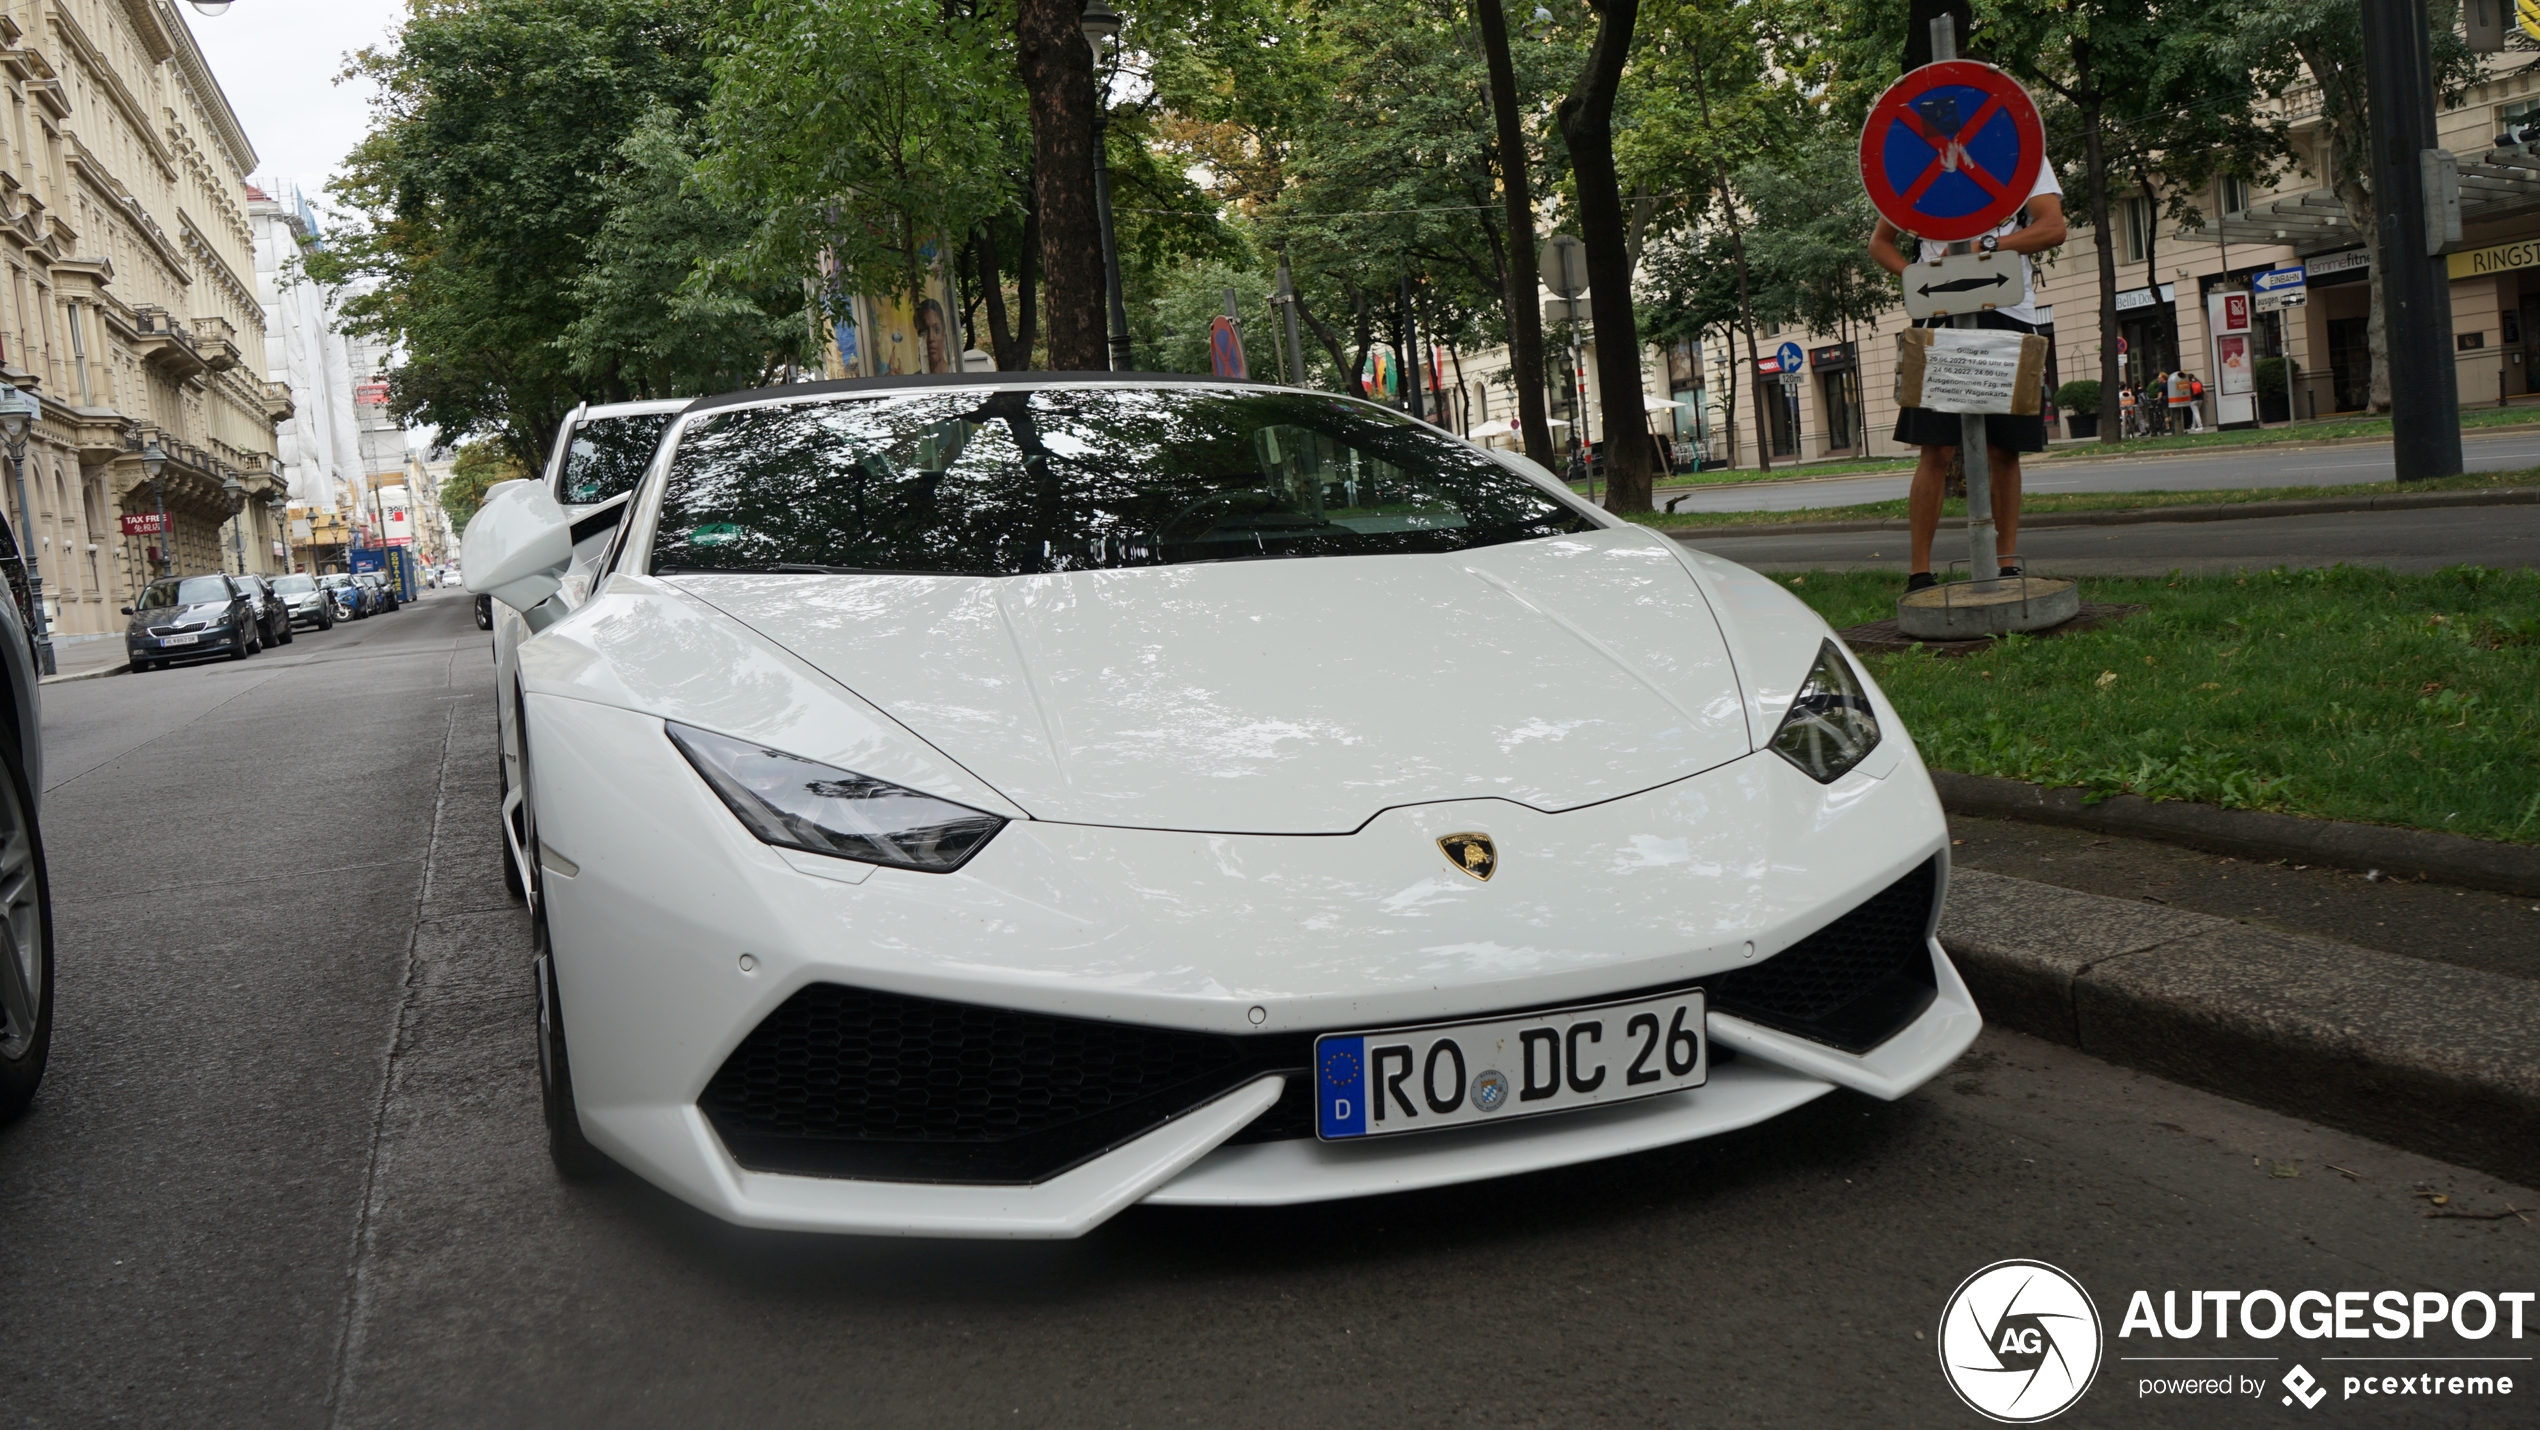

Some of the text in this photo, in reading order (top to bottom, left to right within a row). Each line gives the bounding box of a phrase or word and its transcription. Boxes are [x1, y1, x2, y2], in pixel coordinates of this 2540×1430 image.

[2269, 272, 2300, 285] EINBAHN
[2116, 293, 2137, 309] Bella
[1956, 347, 1978, 355] Gültig
[1782, 374, 1802, 383] 120m
[1926, 376, 1982, 387] Ausgenommen
[1983, 380, 1999, 388] Fzg.
[1929, 386, 2008, 398] offizieller Wagenkarte
[125, 515, 144, 524] TAX
[1371, 1005, 1699, 1121] RO DC 26
[1335, 1098, 1351, 1121] D
